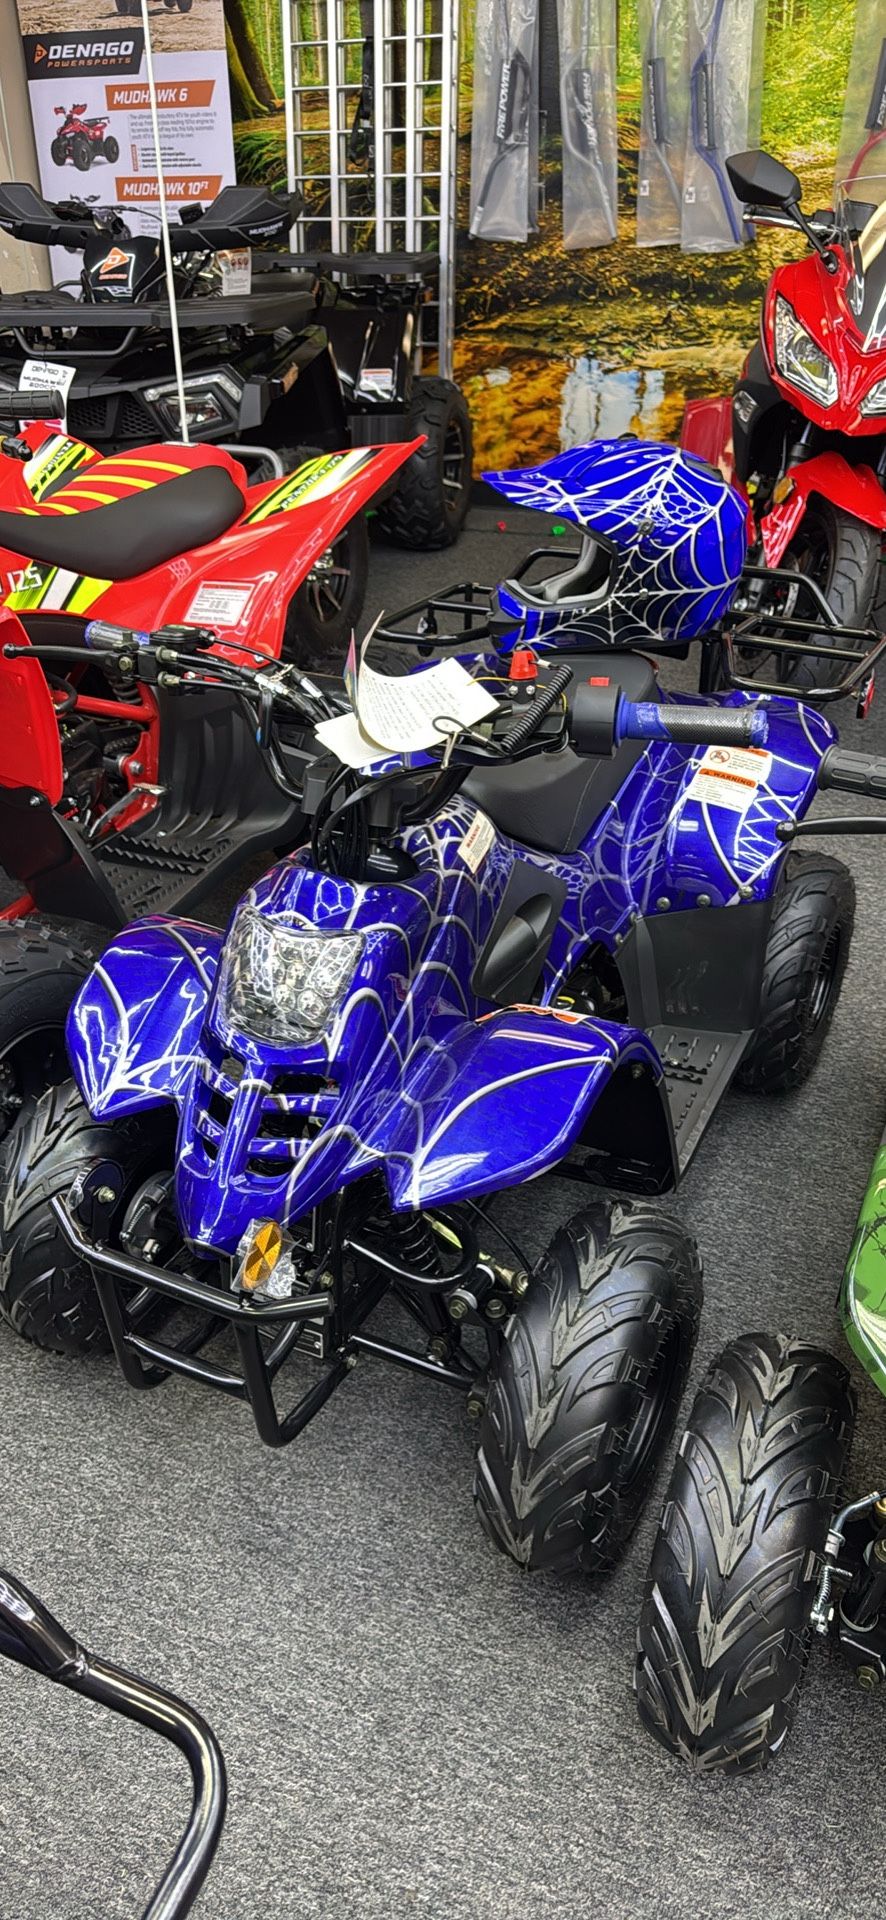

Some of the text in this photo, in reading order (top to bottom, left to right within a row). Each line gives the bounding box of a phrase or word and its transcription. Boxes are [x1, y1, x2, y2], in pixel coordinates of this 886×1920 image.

[48, 41, 134, 59] DENAGO
[47, 57, 131, 68] POWERSPORTS
[113, 87, 189, 105] MUDHWK 6
[123, 182, 185, 196] MUDHWK
[6, 566, 43, 593] 125
[713, 772, 753, 787] WARNING
